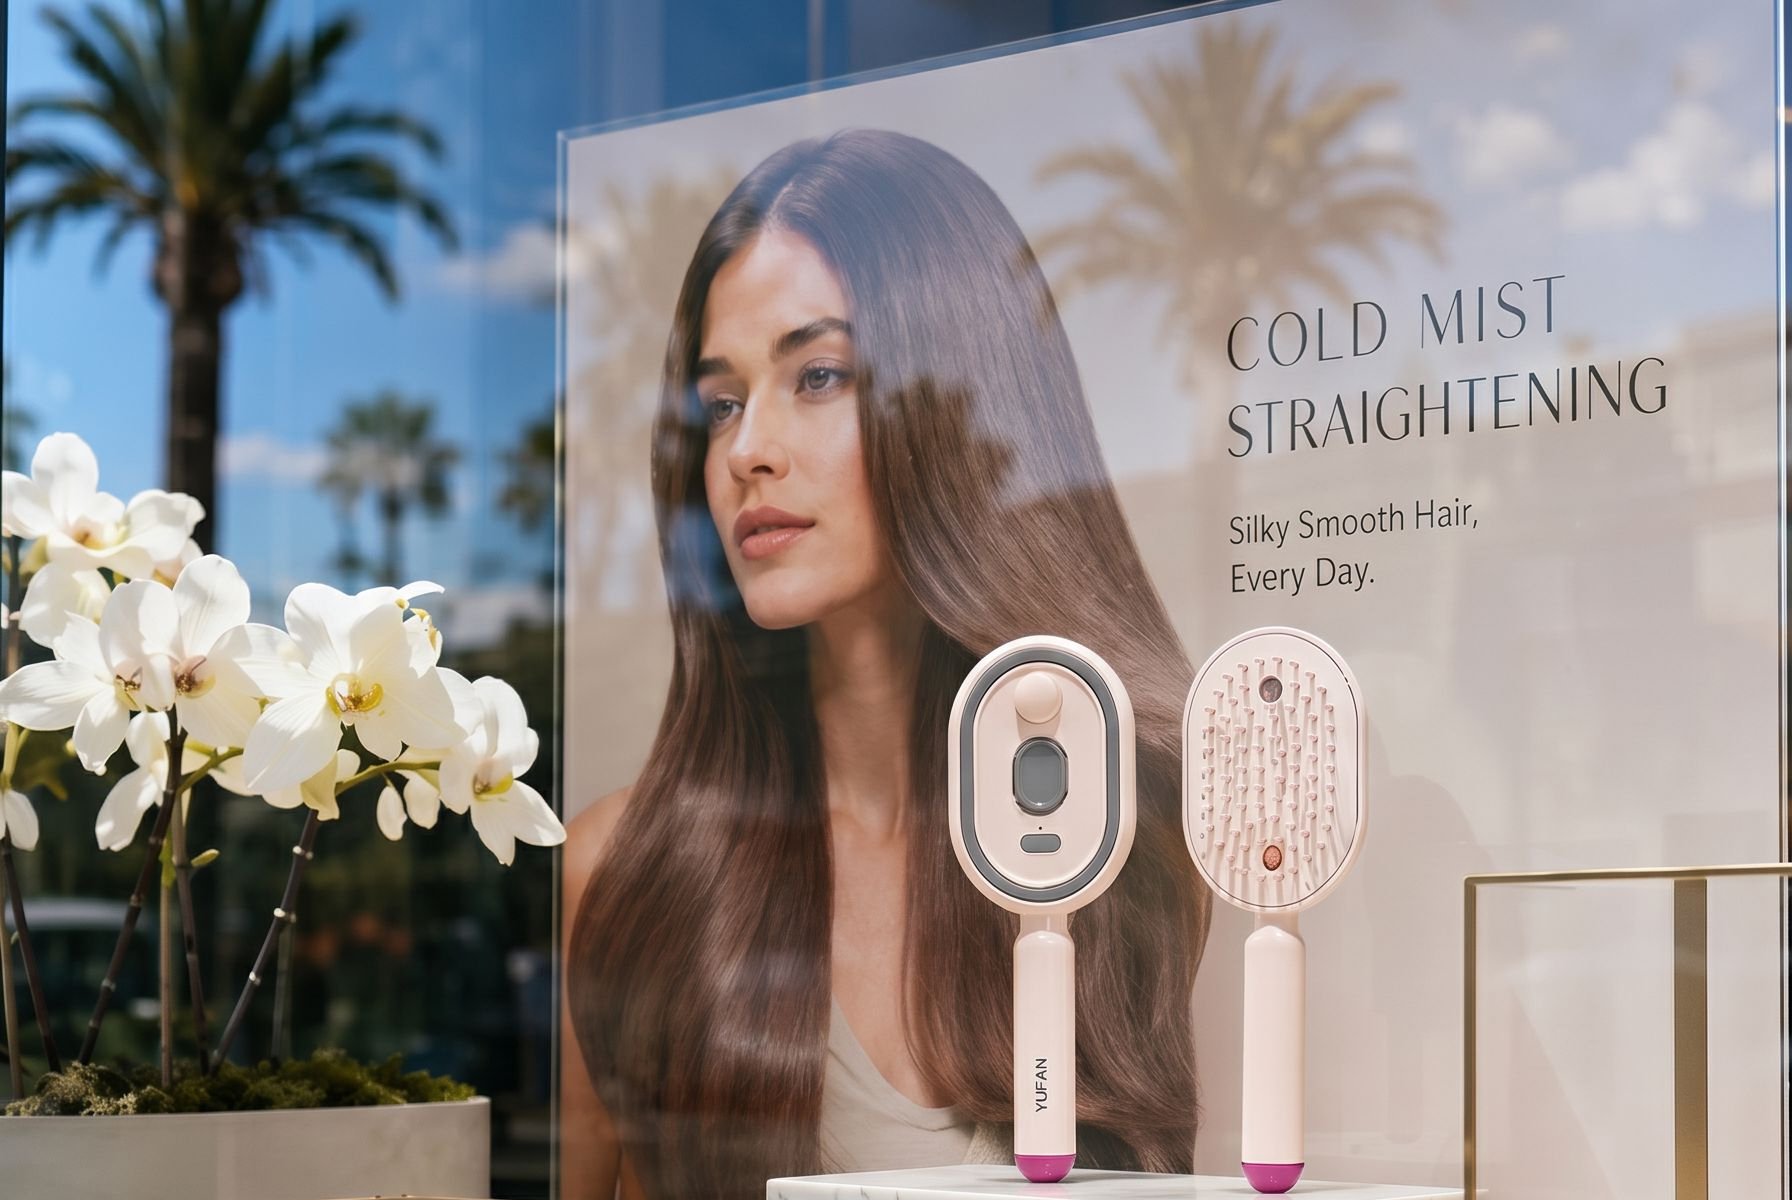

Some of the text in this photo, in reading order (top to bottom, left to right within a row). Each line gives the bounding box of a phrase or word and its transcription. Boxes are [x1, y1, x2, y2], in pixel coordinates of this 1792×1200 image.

[1227, 275, 1566, 371] COLD MIST
[1227, 357, 1667, 458] STRAIGHTENING
[1229, 498, 1478, 549] Silky Smooth Hair,
[1232, 558, 1375, 597] Every Day.
[1035, 1058, 1048, 1113] YUFAN
